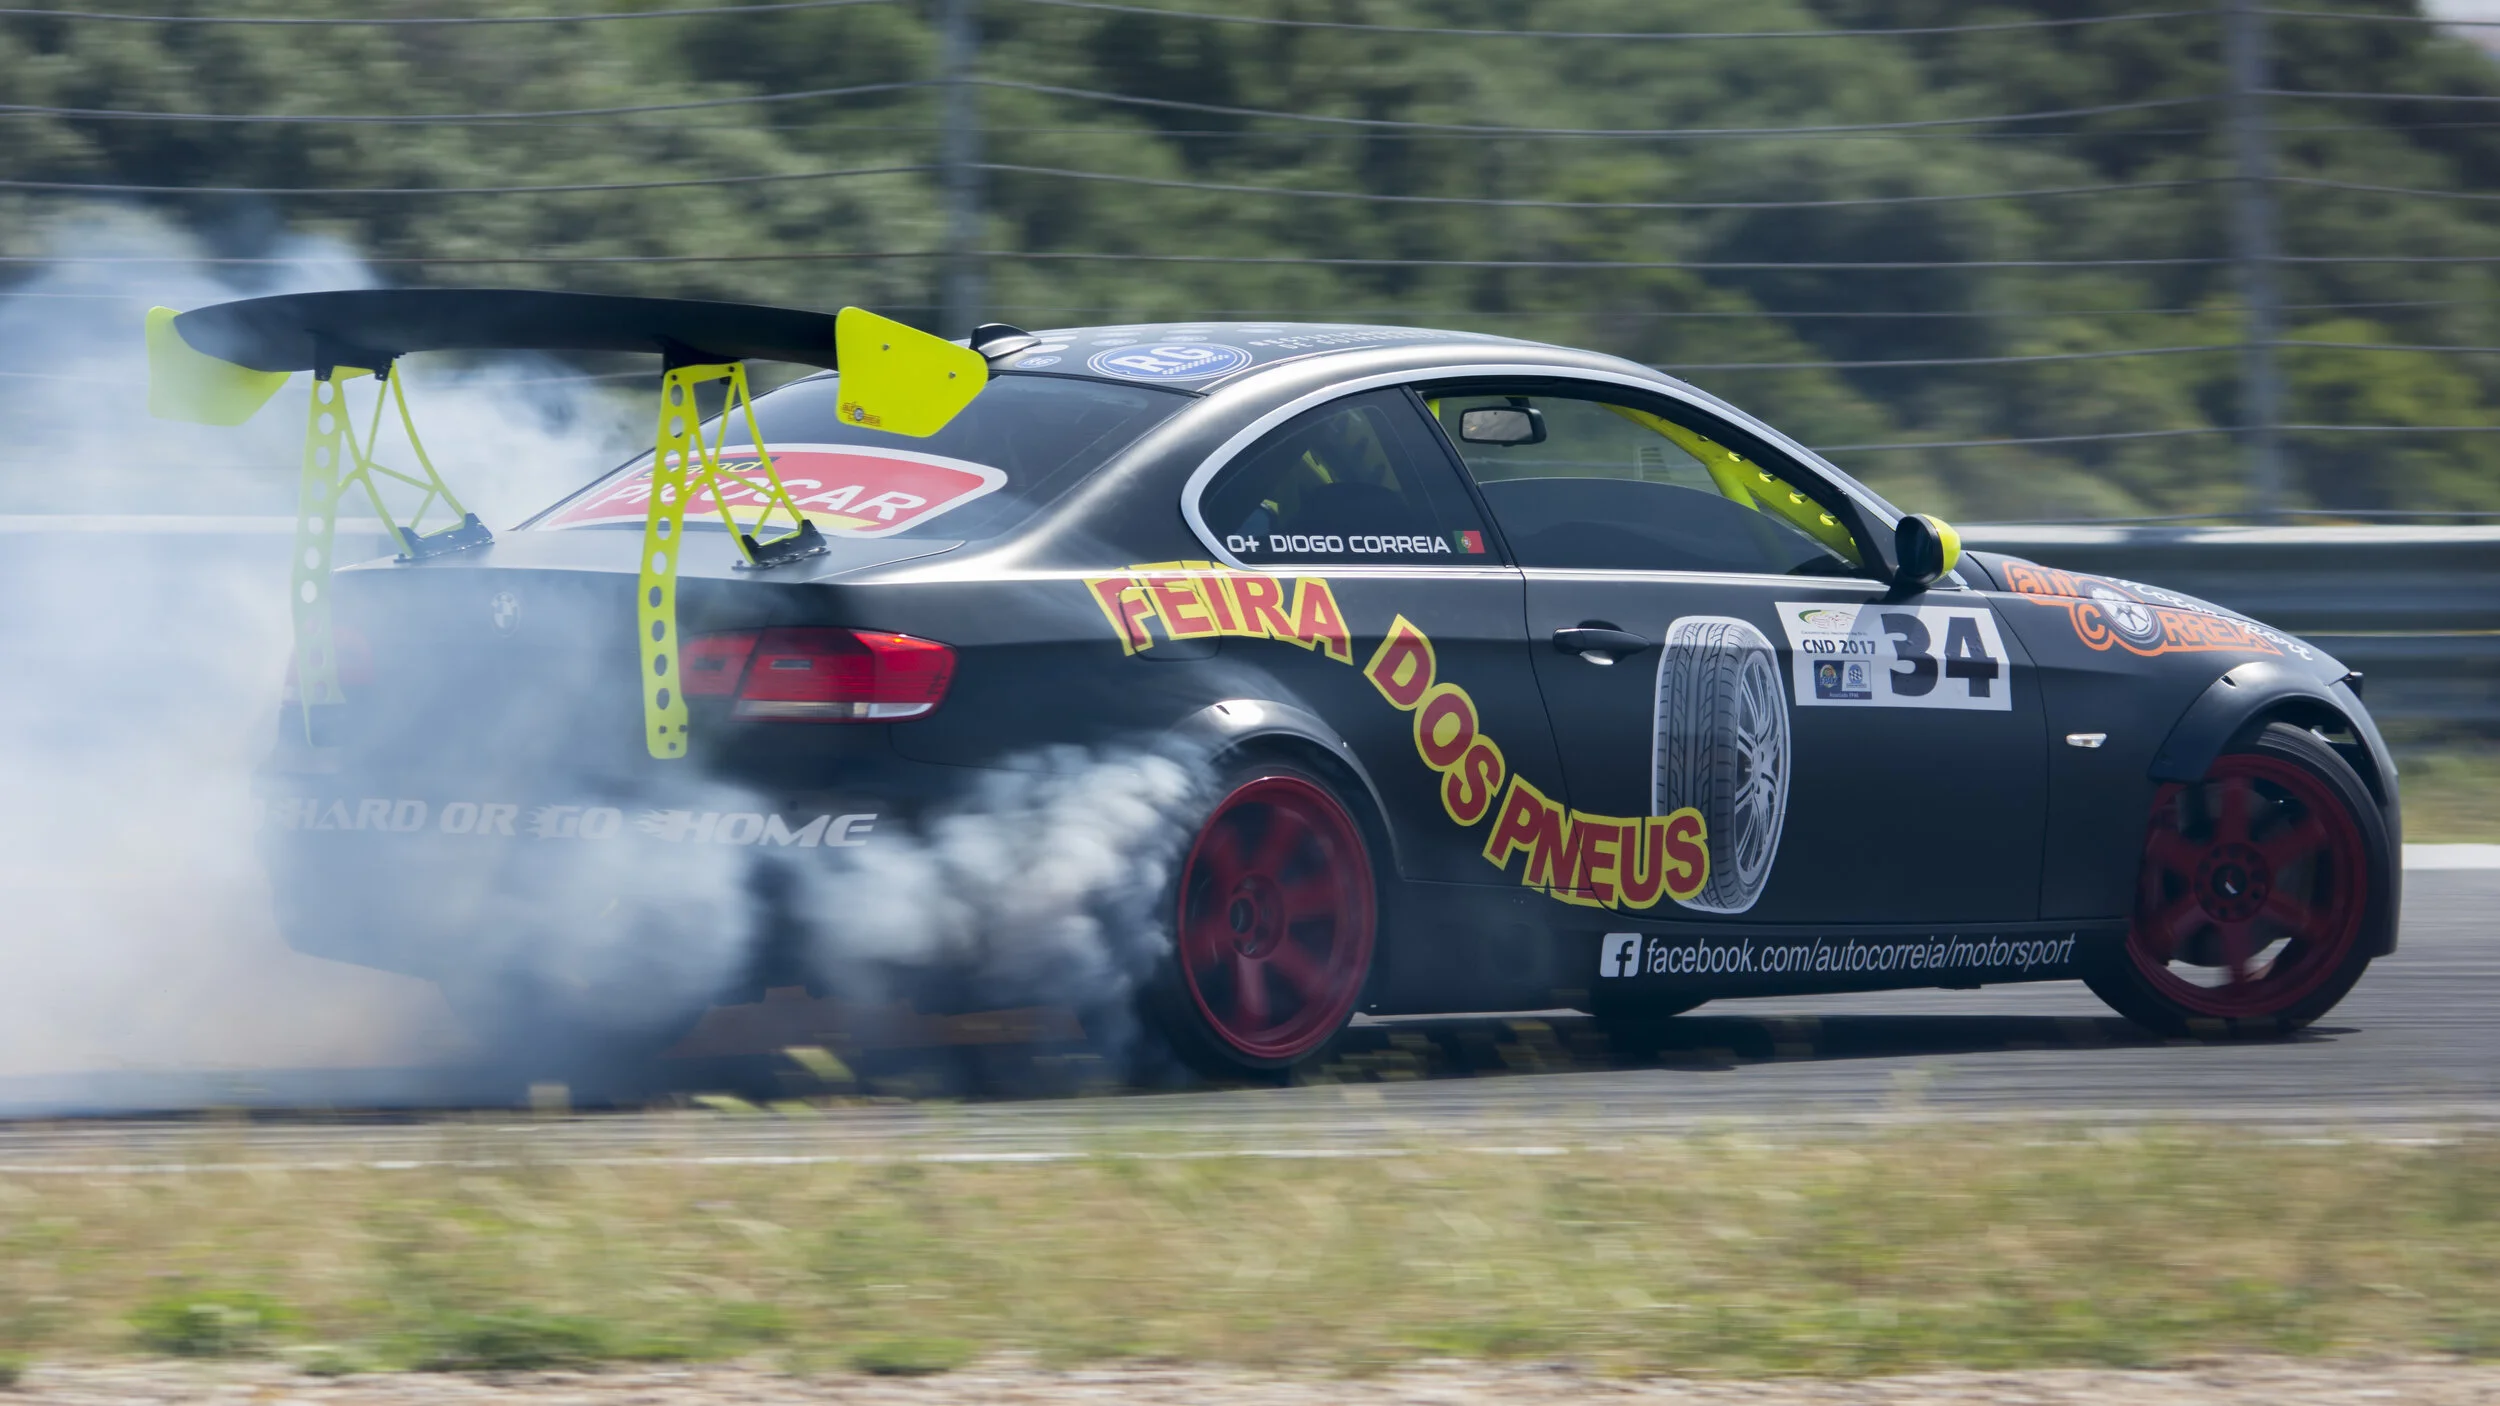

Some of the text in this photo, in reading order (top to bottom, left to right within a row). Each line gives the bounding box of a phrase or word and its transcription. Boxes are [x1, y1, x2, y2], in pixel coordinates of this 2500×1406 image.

[1108, 346, 1214, 373] RG
[1269, 535, 1344, 552] DIOGO
[1348, 535, 1452, 554] CORREIA
[1802, 639, 1876, 655] CND 2017
[1880, 612, 1999, 698] 34
[1082, 561, 1710, 909] FEIRA DOS PNEUS
[278, 797, 428, 832] HARD
[439, 802, 518, 836] OR
[529, 804, 623, 839] GO
[640, 809, 878, 847] HOME
[1646, 933, 2076, 974] facebook.com/autocorreia/motorsport
